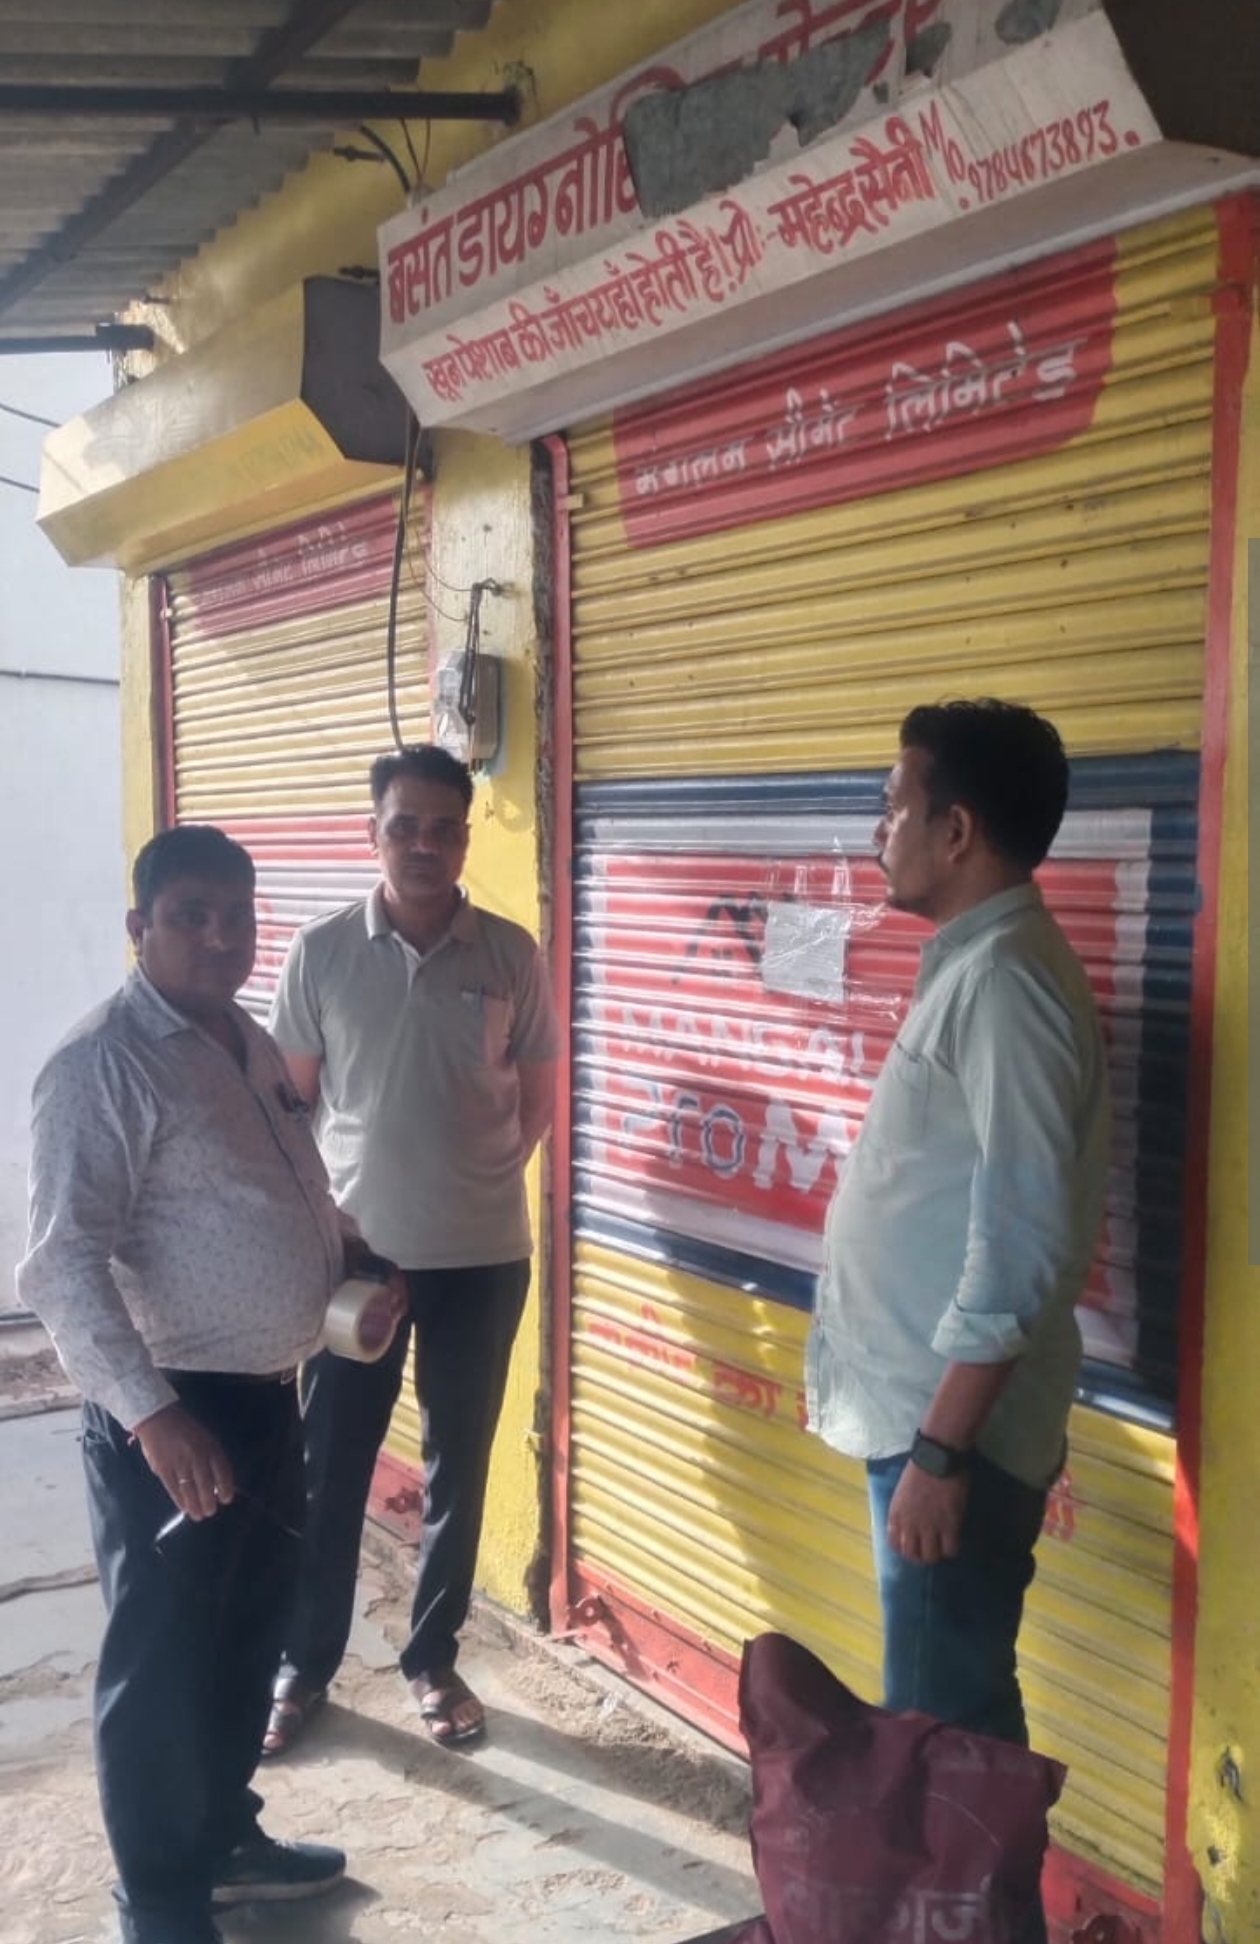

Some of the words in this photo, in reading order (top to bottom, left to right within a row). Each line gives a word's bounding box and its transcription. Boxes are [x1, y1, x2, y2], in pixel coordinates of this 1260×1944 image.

[388, 206, 455, 324] बसंत
[508, 301, 553, 363] की
[627, 231, 699, 327] होती
[849, 116, 936, 226] सैनी
